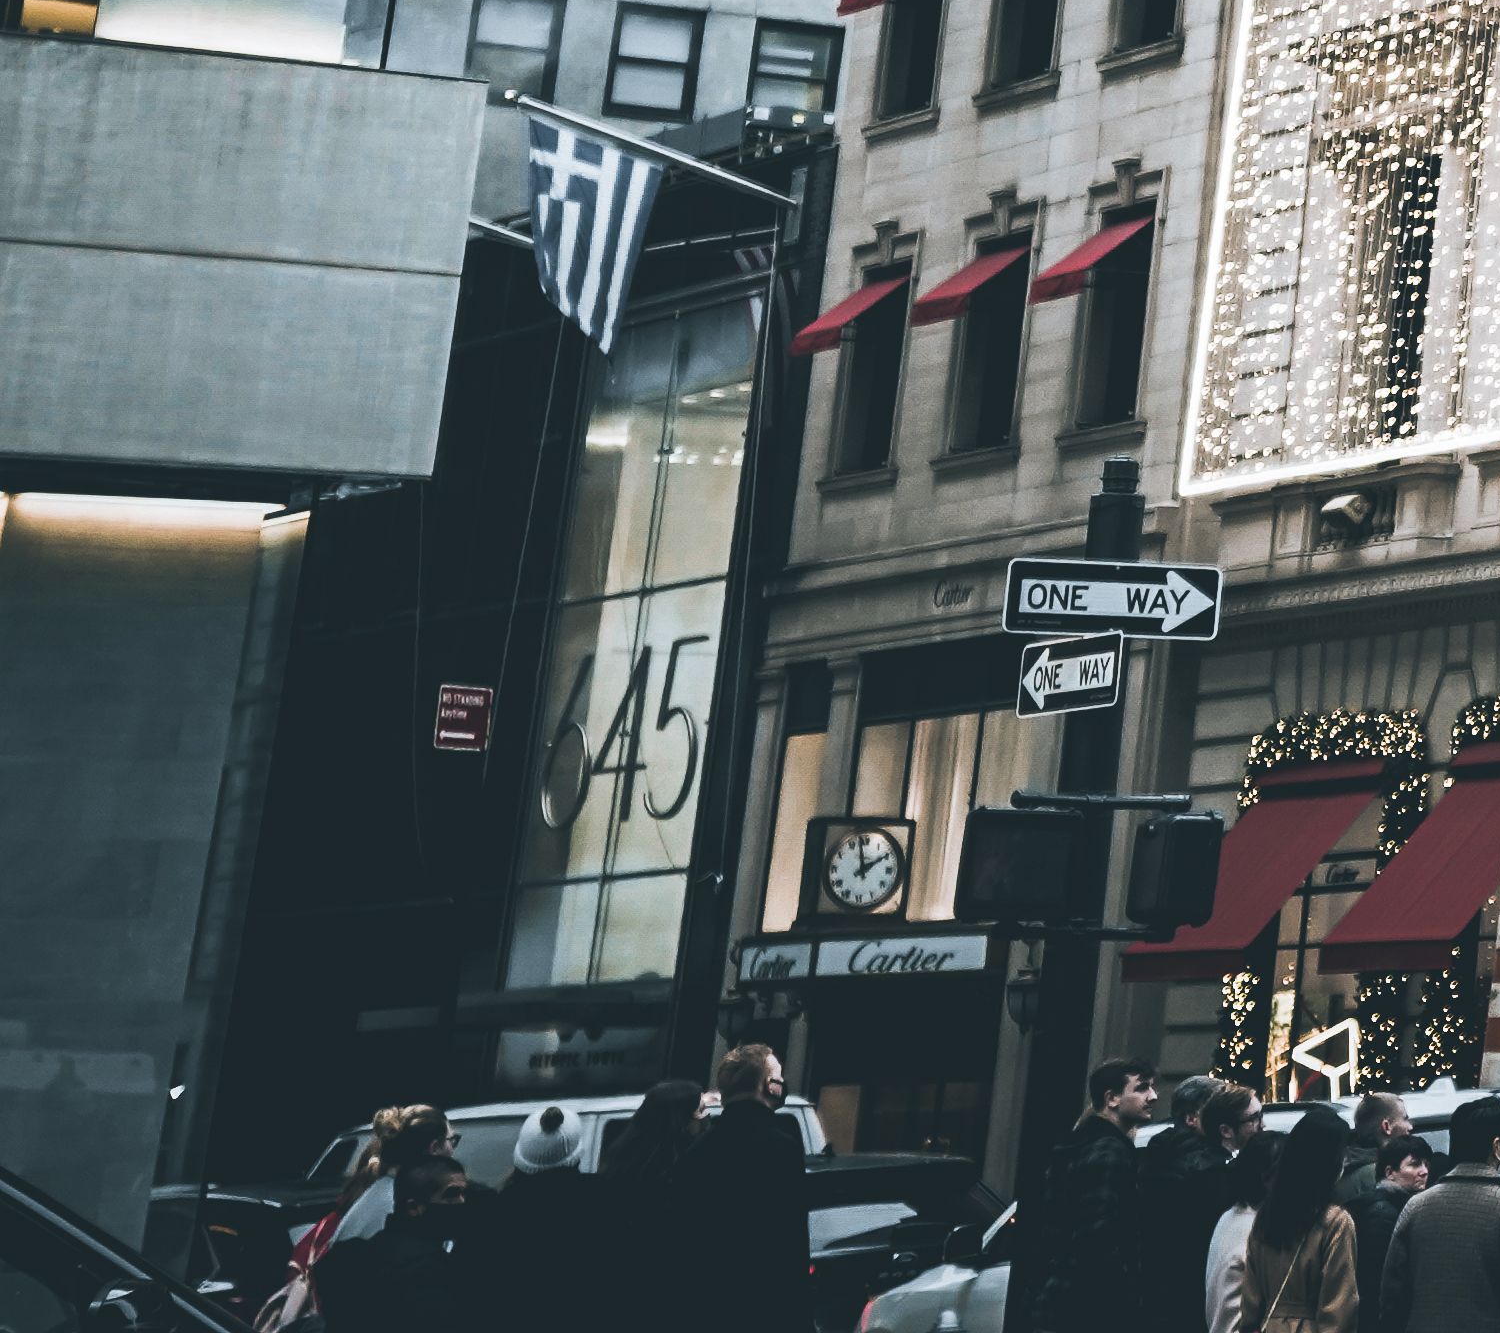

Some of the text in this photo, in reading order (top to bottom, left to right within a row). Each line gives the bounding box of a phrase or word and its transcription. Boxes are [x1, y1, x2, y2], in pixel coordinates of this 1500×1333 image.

[933, 581, 973, 608] Cartier
[1027, 583, 1191, 616] ONE WAY
[1033, 656, 1112, 694] ONE WAY
[540, 635, 710, 829] 645
[750, 946, 797, 980] Cartier
[848, 940, 955, 974] Cartier
